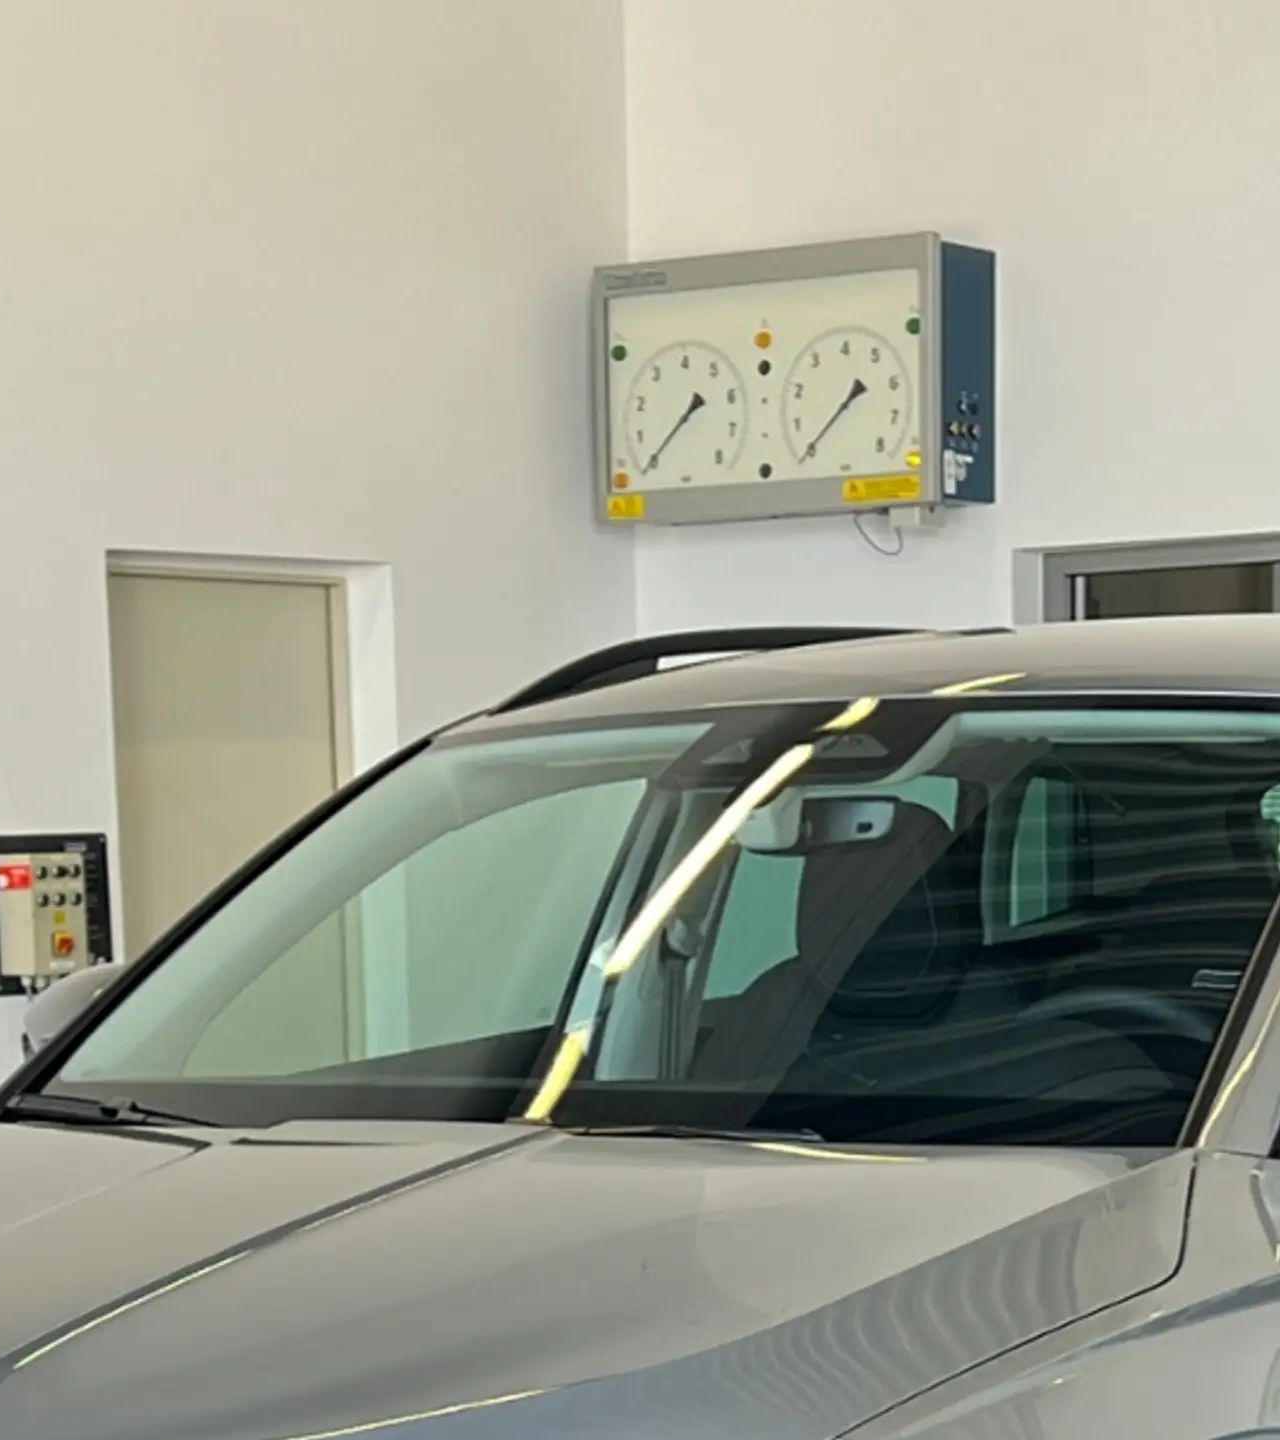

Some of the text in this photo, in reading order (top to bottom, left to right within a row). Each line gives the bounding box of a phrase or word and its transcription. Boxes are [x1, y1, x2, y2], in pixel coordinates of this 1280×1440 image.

[839, 341, 850, 356] 4
[870, 348, 880, 364] 5
[680, 355, 690, 370] 4
[809, 353, 821, 369] 3
[651, 366, 661, 383] 3
[708, 362, 719, 378] 5
[793, 382, 804, 400] 2
[888, 375, 900, 391] 6
[636, 396, 646, 412] 2
[726, 388, 737, 404] 6
[793, 417, 801, 432] 1
[890, 408, 899, 425] 7
[636, 430, 644, 444] 1
[728, 422, 737, 438] 7
